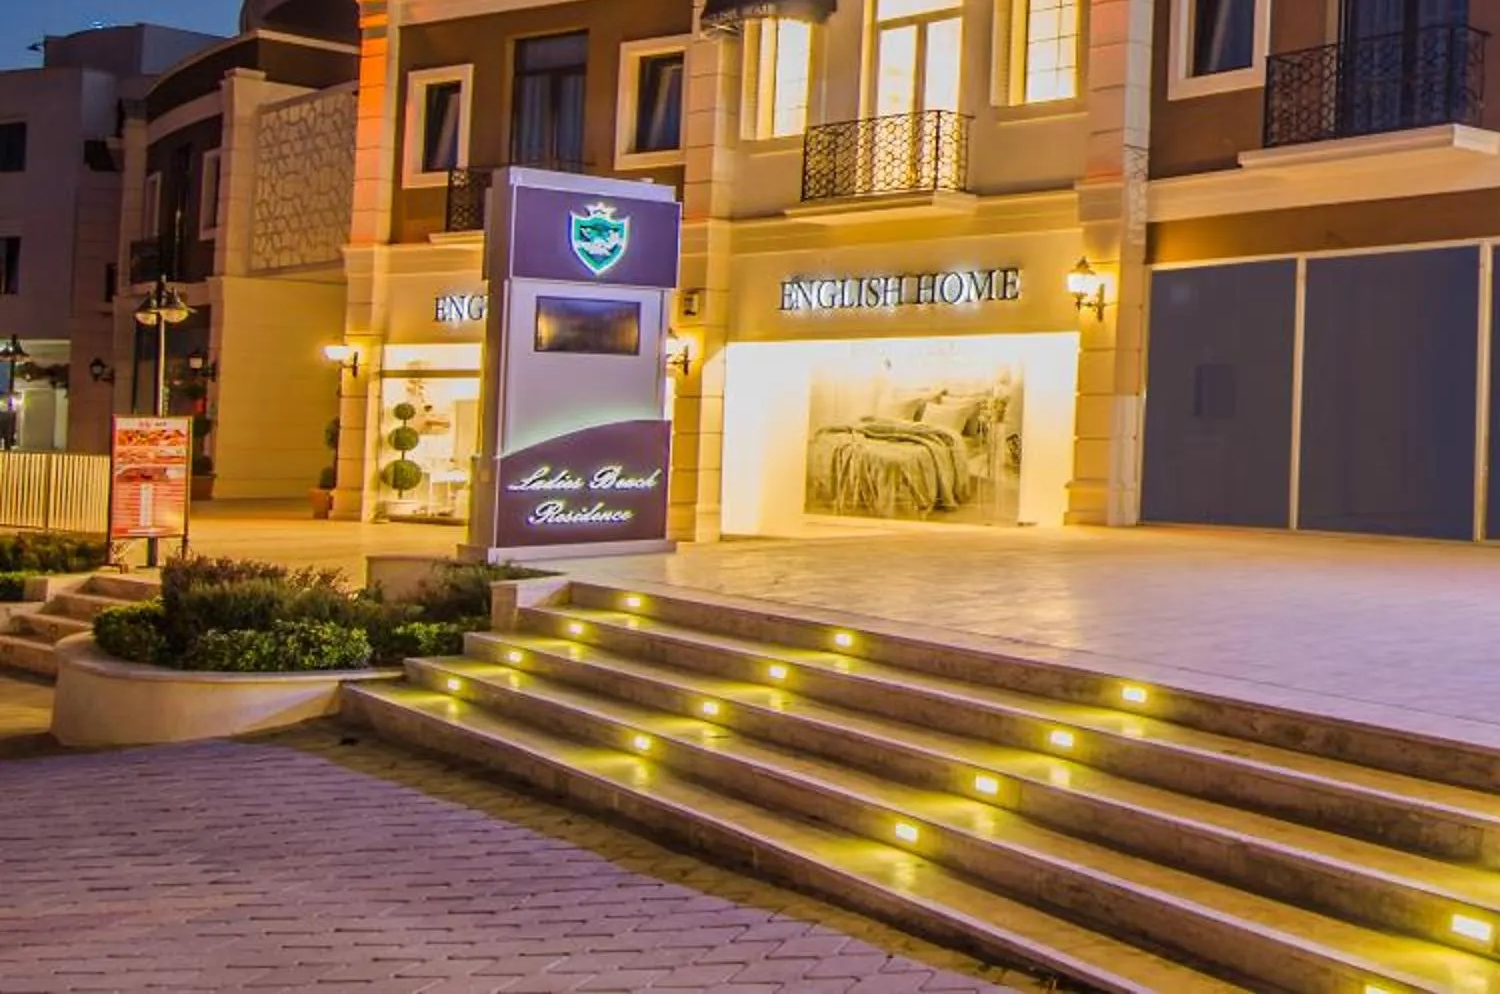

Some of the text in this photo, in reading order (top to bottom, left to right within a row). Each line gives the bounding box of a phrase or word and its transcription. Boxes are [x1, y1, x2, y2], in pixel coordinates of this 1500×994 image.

[779, 267, 1020, 311] ENGLISH HOME
[434, 293, 484, 322] ENG
[507, 464, 662, 491] Ladies Beach
[528, 499, 633, 525] Residence
